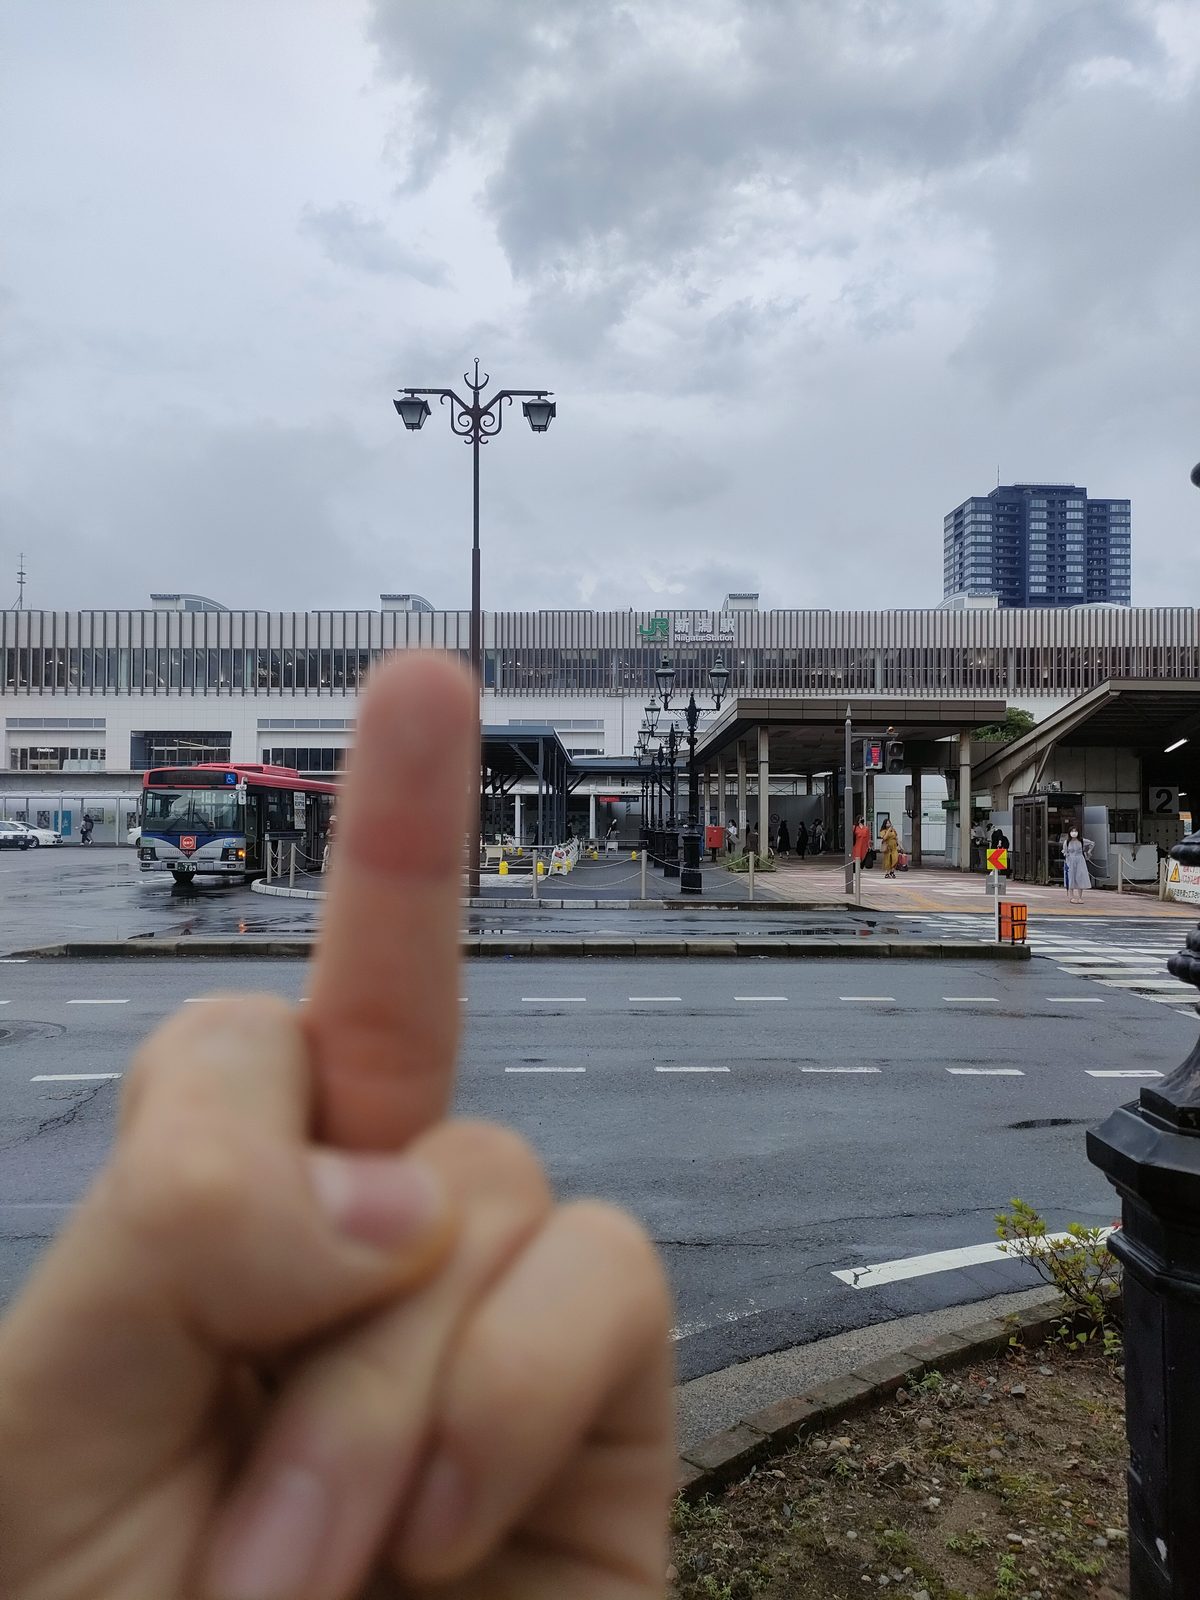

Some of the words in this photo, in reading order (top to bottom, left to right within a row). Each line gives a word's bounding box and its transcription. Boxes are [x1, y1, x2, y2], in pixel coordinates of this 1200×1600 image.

[639, 618, 669, 635] JR
[675, 618, 734, 632] 新潟駅
[675, 634, 703, 642] Niigata
[1156, 788, 1172, 813] 2
